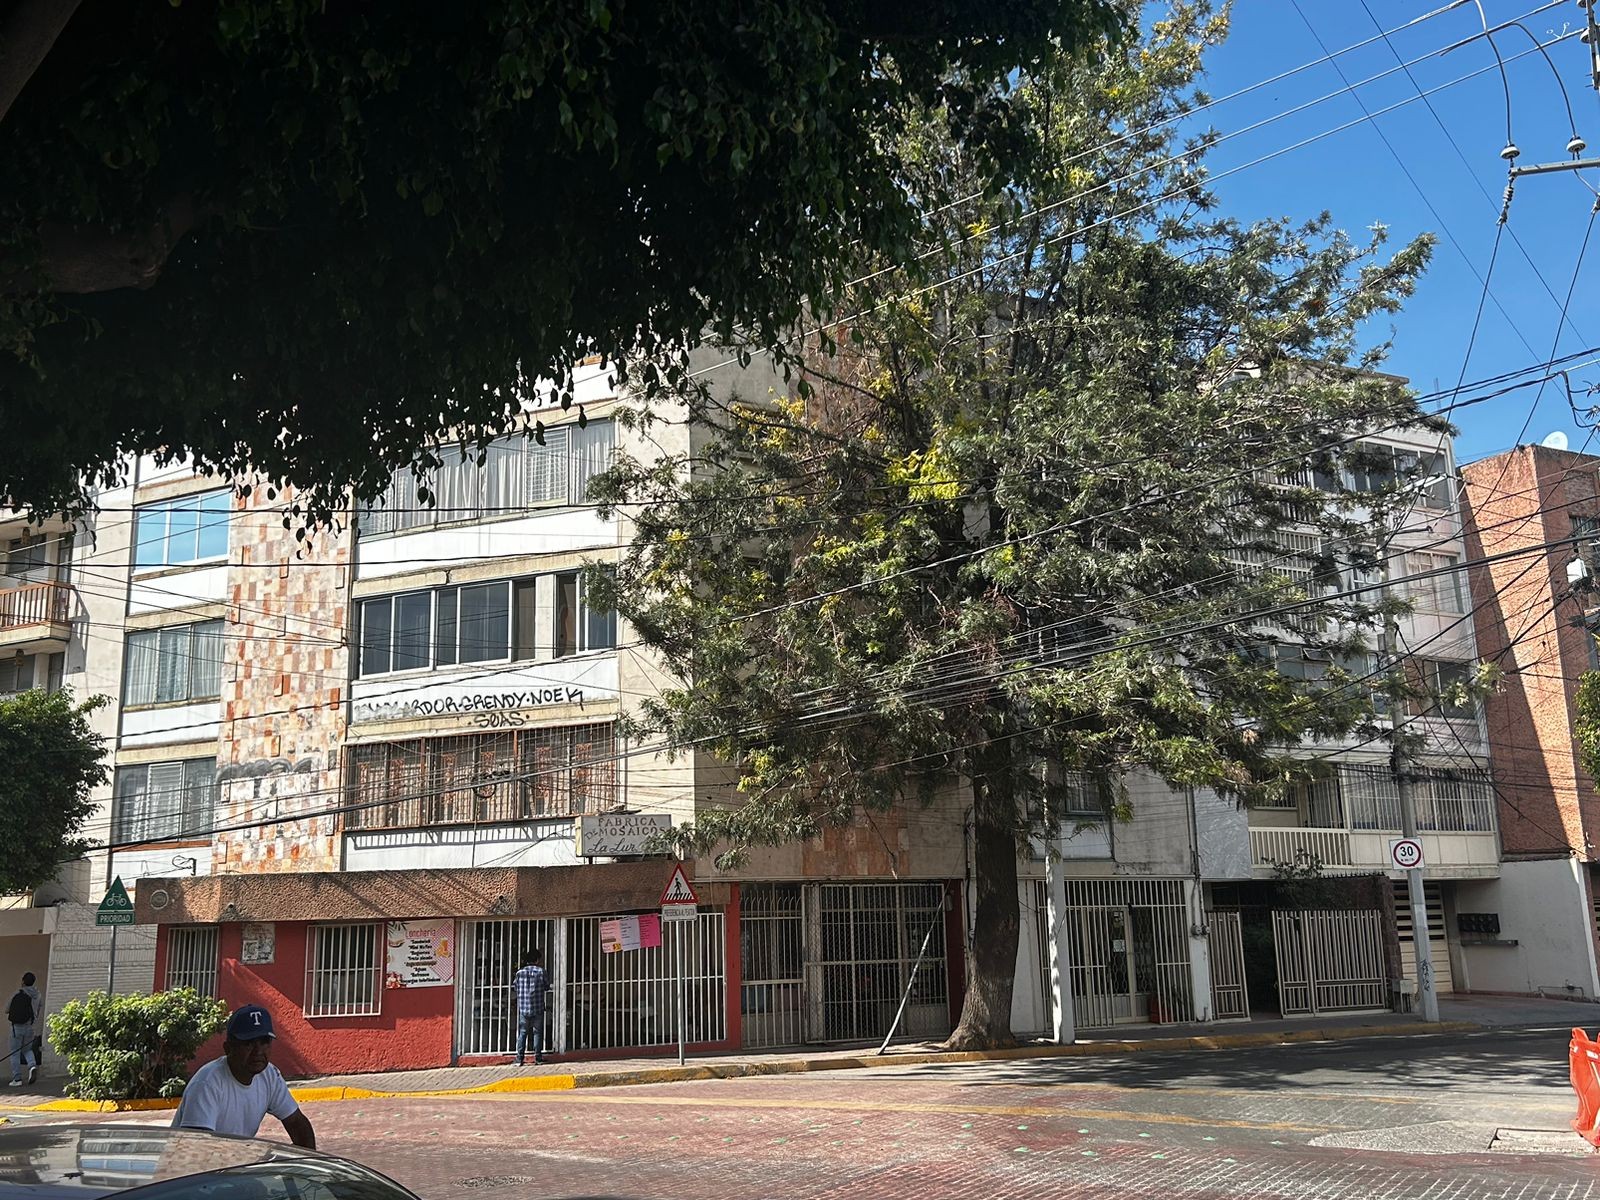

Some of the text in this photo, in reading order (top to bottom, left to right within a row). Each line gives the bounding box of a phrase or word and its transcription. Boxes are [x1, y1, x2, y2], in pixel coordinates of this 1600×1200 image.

[598, 817, 657, 827] FABRICA
[587, 838, 608, 853] La
[1399, 845, 1414, 857] 30
[100, 915, 131, 924] PRIORIDAD
[249, 1011, 262, 1026] T
